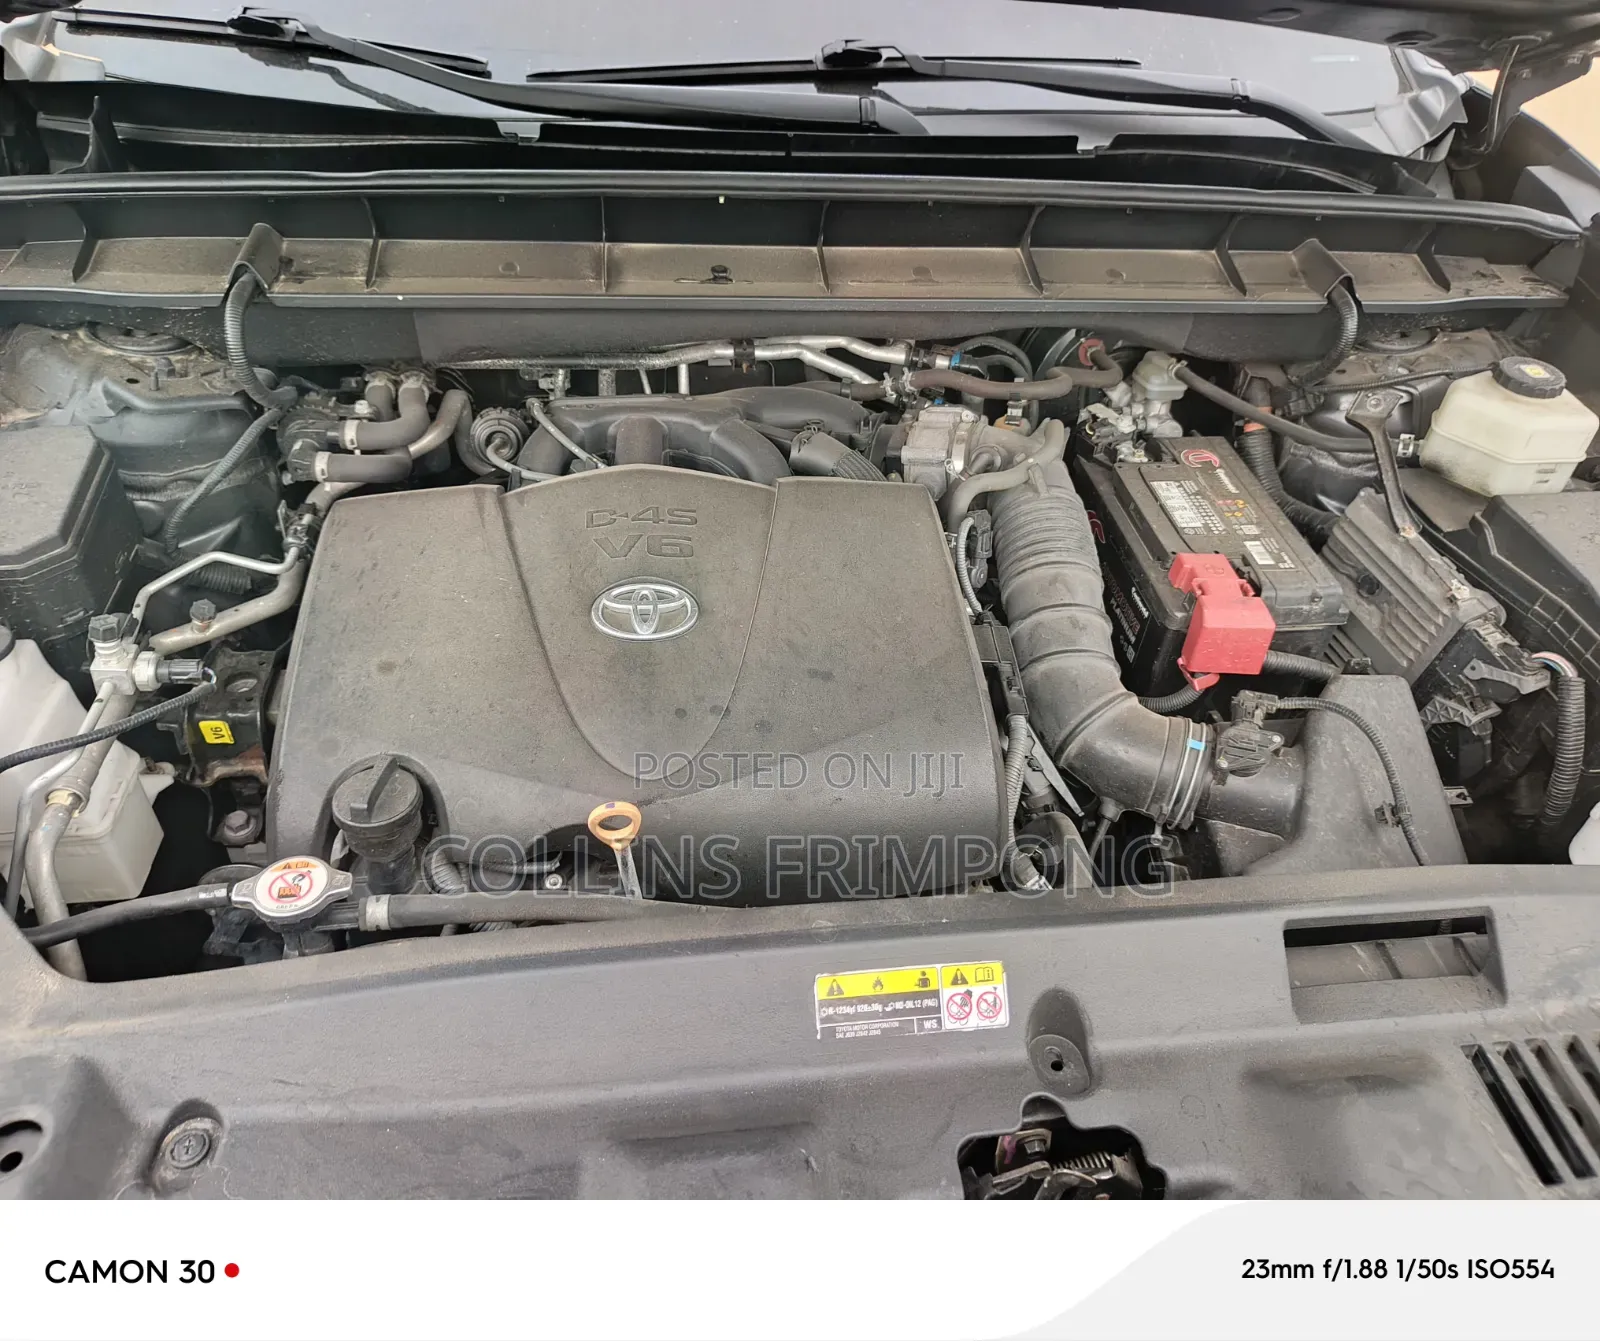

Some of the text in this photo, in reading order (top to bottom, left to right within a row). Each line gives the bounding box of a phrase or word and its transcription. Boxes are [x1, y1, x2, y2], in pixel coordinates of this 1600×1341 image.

[585, 506, 698, 528] D-4S
[592, 533, 694, 559] V6
[210, 726, 226, 740] V6
